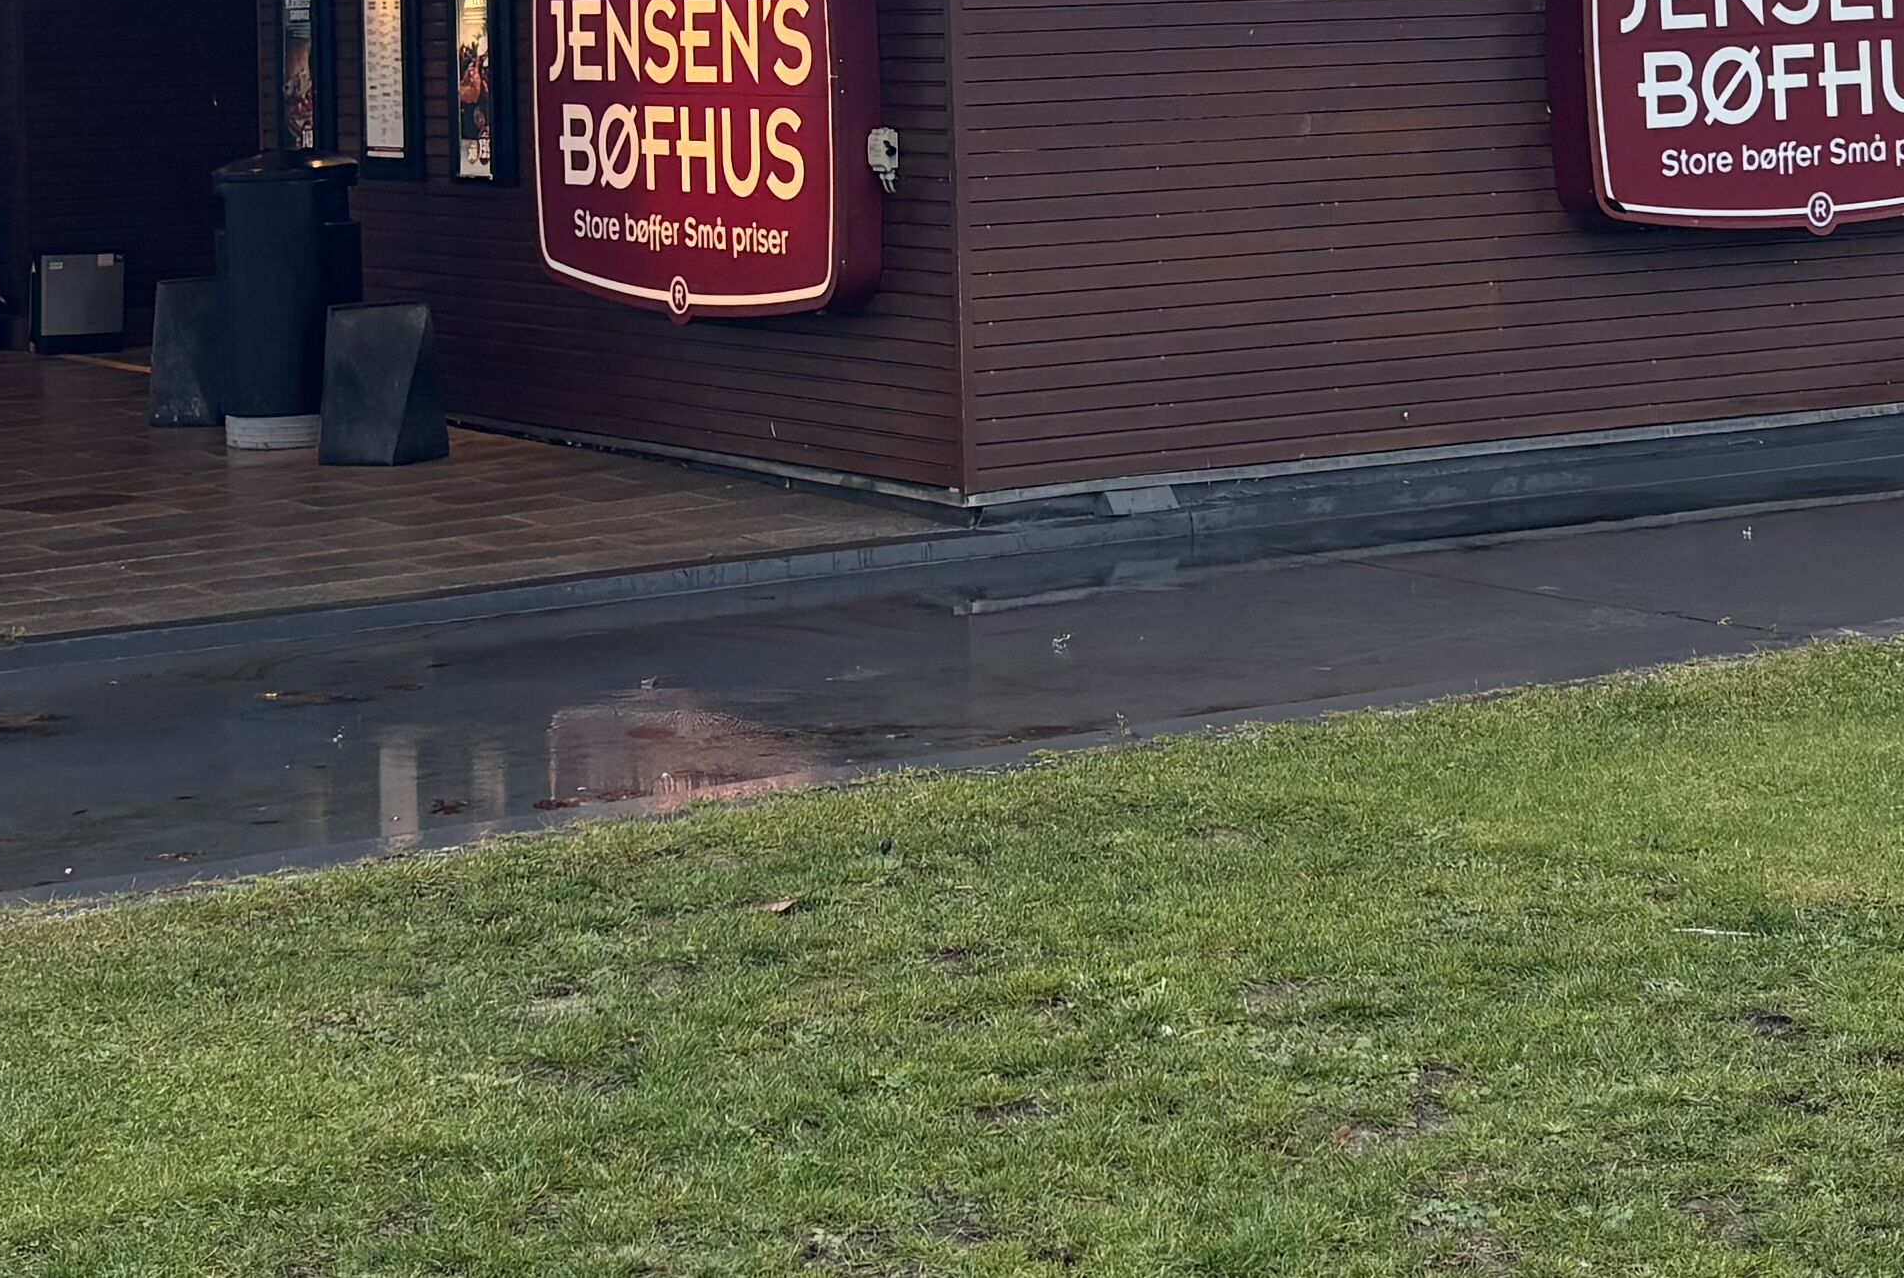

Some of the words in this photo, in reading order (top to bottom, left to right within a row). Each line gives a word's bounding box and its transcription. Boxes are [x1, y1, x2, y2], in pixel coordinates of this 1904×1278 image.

[559, 103, 805, 201] BØFHUS
[1660, 149, 1734, 178] Store
[1742, 140, 1822, 175] bøffer
[1829, 133, 1887, 165] Små
[573, 208, 621, 241] Store
[624, 212, 680, 252] bøffer
[684, 216, 727, 250] Små
[731, 222, 790, 259] priser
